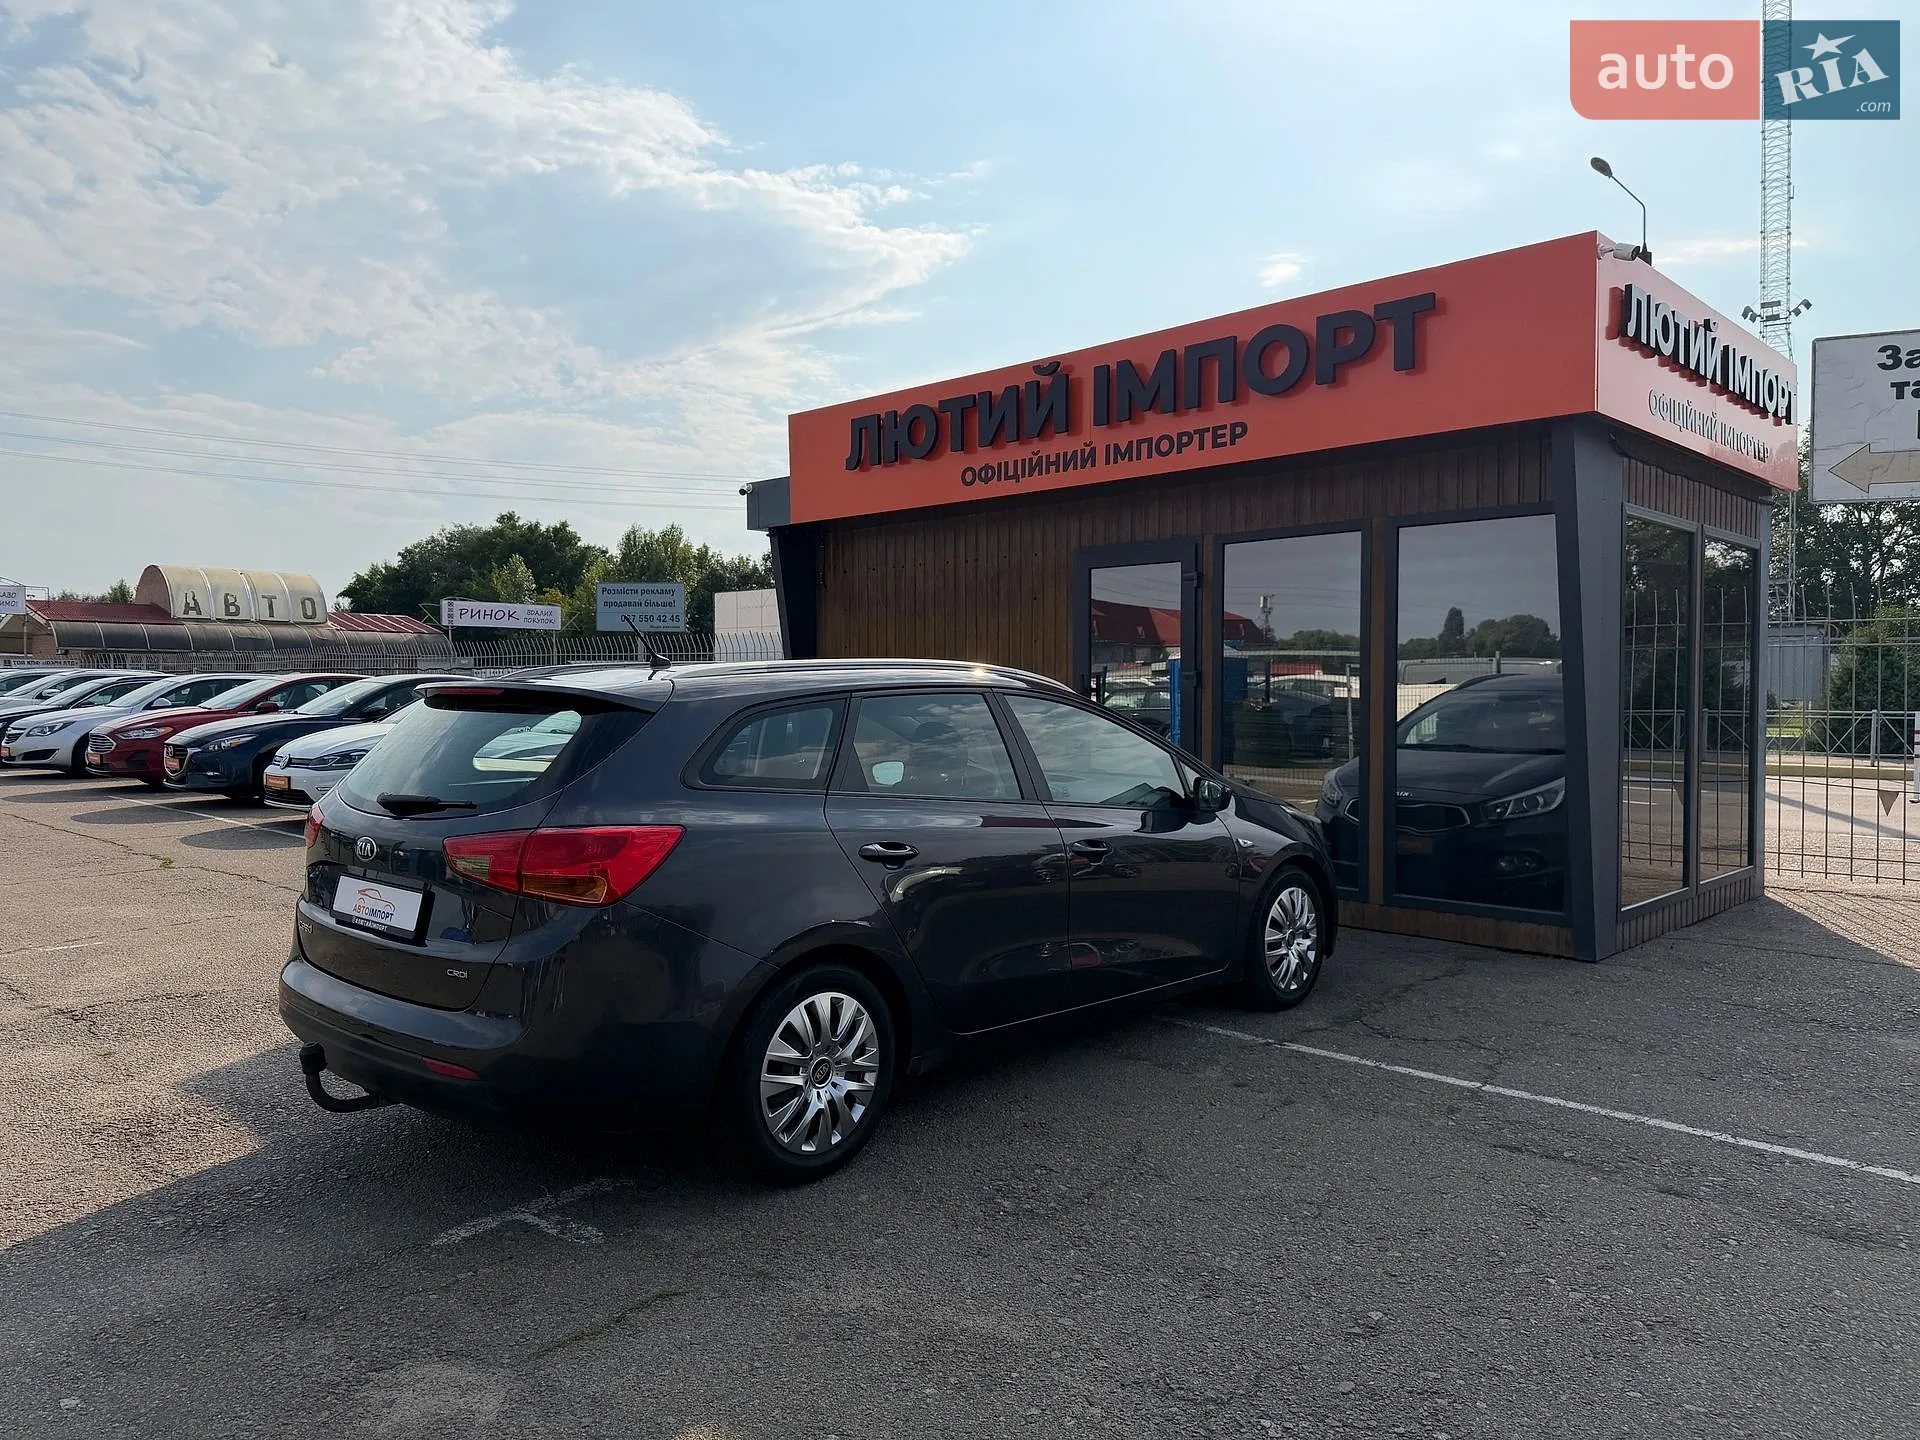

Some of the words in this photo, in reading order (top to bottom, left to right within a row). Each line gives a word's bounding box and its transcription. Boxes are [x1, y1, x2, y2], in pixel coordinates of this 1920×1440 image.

[1620, 283, 1722, 386] ЛЮТИЙ
[1723, 344, 1797, 426] ІМПОРТ
[845, 361, 1070, 471] ЛЮТИЙ
[1092, 292, 1437, 427] ІМПОРТ
[961, 441, 1097, 487] ОФІЦІЙНИЙ
[1104, 421, 1249, 466] ІМПОРТЕР
[601, 587, 639, 596] Розмісти
[640, 588, 676, 597] рекламу
[183, 591, 317, 620] АВТО
[644, 599, 676, 608] більше!
[459, 608, 520, 621] РИНОК
[639, 614, 655, 623] 550
[656, 614, 668, 623] 42
[356, 841, 372, 857] KIA
[352, 903, 394, 922] АВТОІМПОРТ
